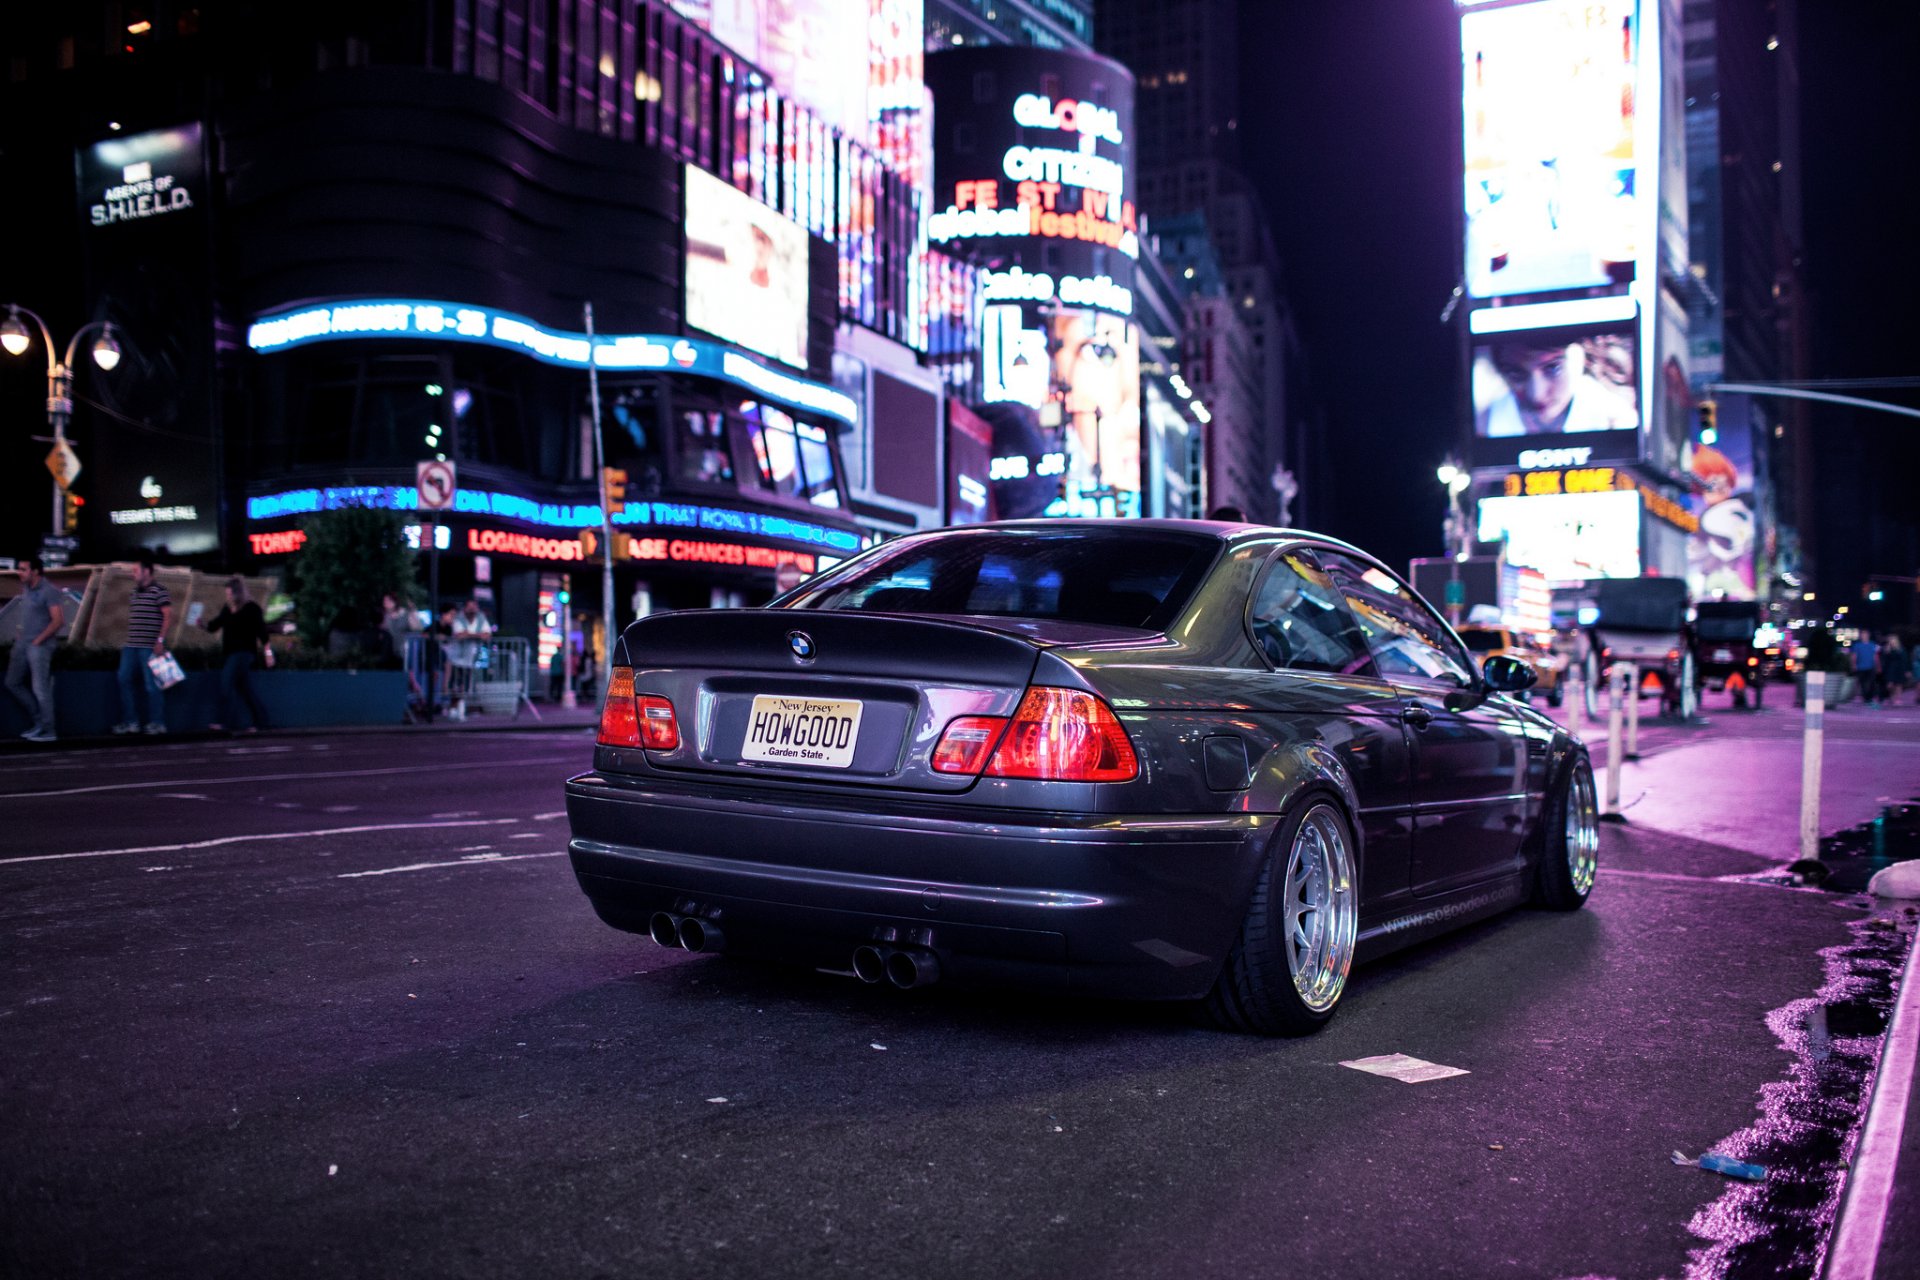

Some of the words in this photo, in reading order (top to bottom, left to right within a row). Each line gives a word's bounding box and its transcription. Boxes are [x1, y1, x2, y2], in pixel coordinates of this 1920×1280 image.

[105, 180, 154, 202] AGENTS
[154, 175, 175, 192] OF
[91, 187, 194, 226] S.H.I.E.L.D.
[1518, 447, 1592, 469] SONY
[628, 538, 668, 559] ASE
[669, 540, 744, 565] CHANCES
[779, 699, 802, 711] New
[802, 701, 834, 715] Jersey
[751, 712, 852, 749] HOWGOOD
[769, 747, 798, 757] Garden
[801, 749, 823, 759] State
